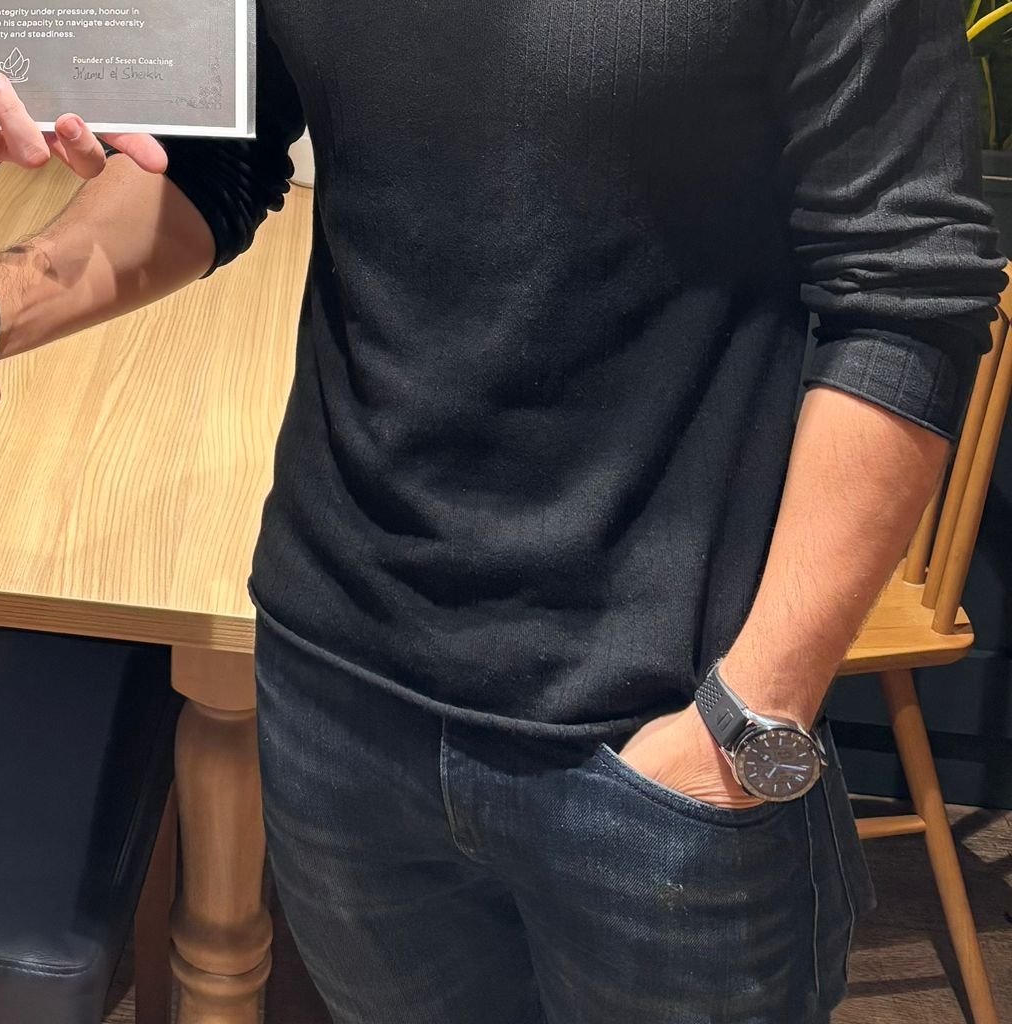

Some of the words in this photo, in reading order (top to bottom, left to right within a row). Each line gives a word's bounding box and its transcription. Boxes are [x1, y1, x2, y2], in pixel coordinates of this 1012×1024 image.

[30, 8, 55, 16] under
[57, 8, 97, 16] pressure,
[131, 7, 140, 15] in
[3, 19, 15, 27] his
[17, 19, 53, 28] capacity
[66, 19, 103, 27] navigate
[104, 19, 145, 28] adversity
[10, 30, 26, 38] and
[27, 30, 75, 38] steadiness.
[72, 56, 103, 64] Founder
[105, 56, 114, 64] of
[115, 56, 137, 64] Sesen
[138, 57, 173, 67] Coaching
